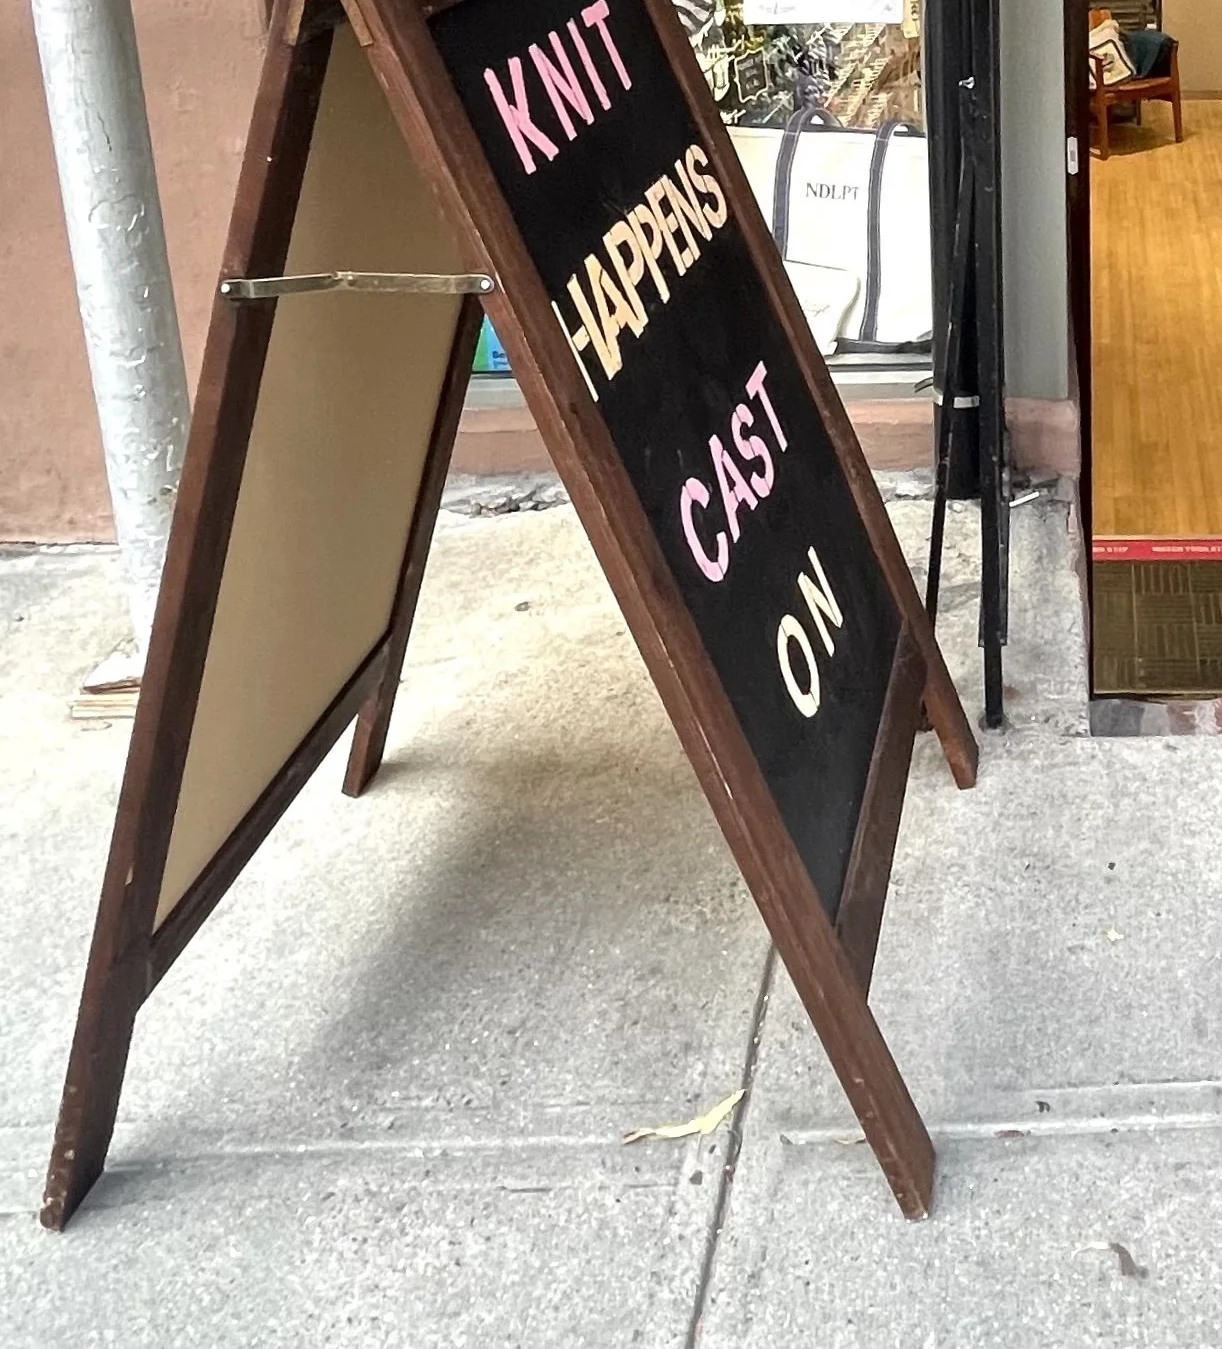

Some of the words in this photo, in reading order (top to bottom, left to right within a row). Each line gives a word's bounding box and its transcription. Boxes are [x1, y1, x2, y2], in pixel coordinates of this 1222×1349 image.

[551, 144, 728, 402] HAPPENS
[805, 182, 860, 201] NDLPT
[679, 360, 789, 583] CAST
[777, 546, 844, 719] ON
